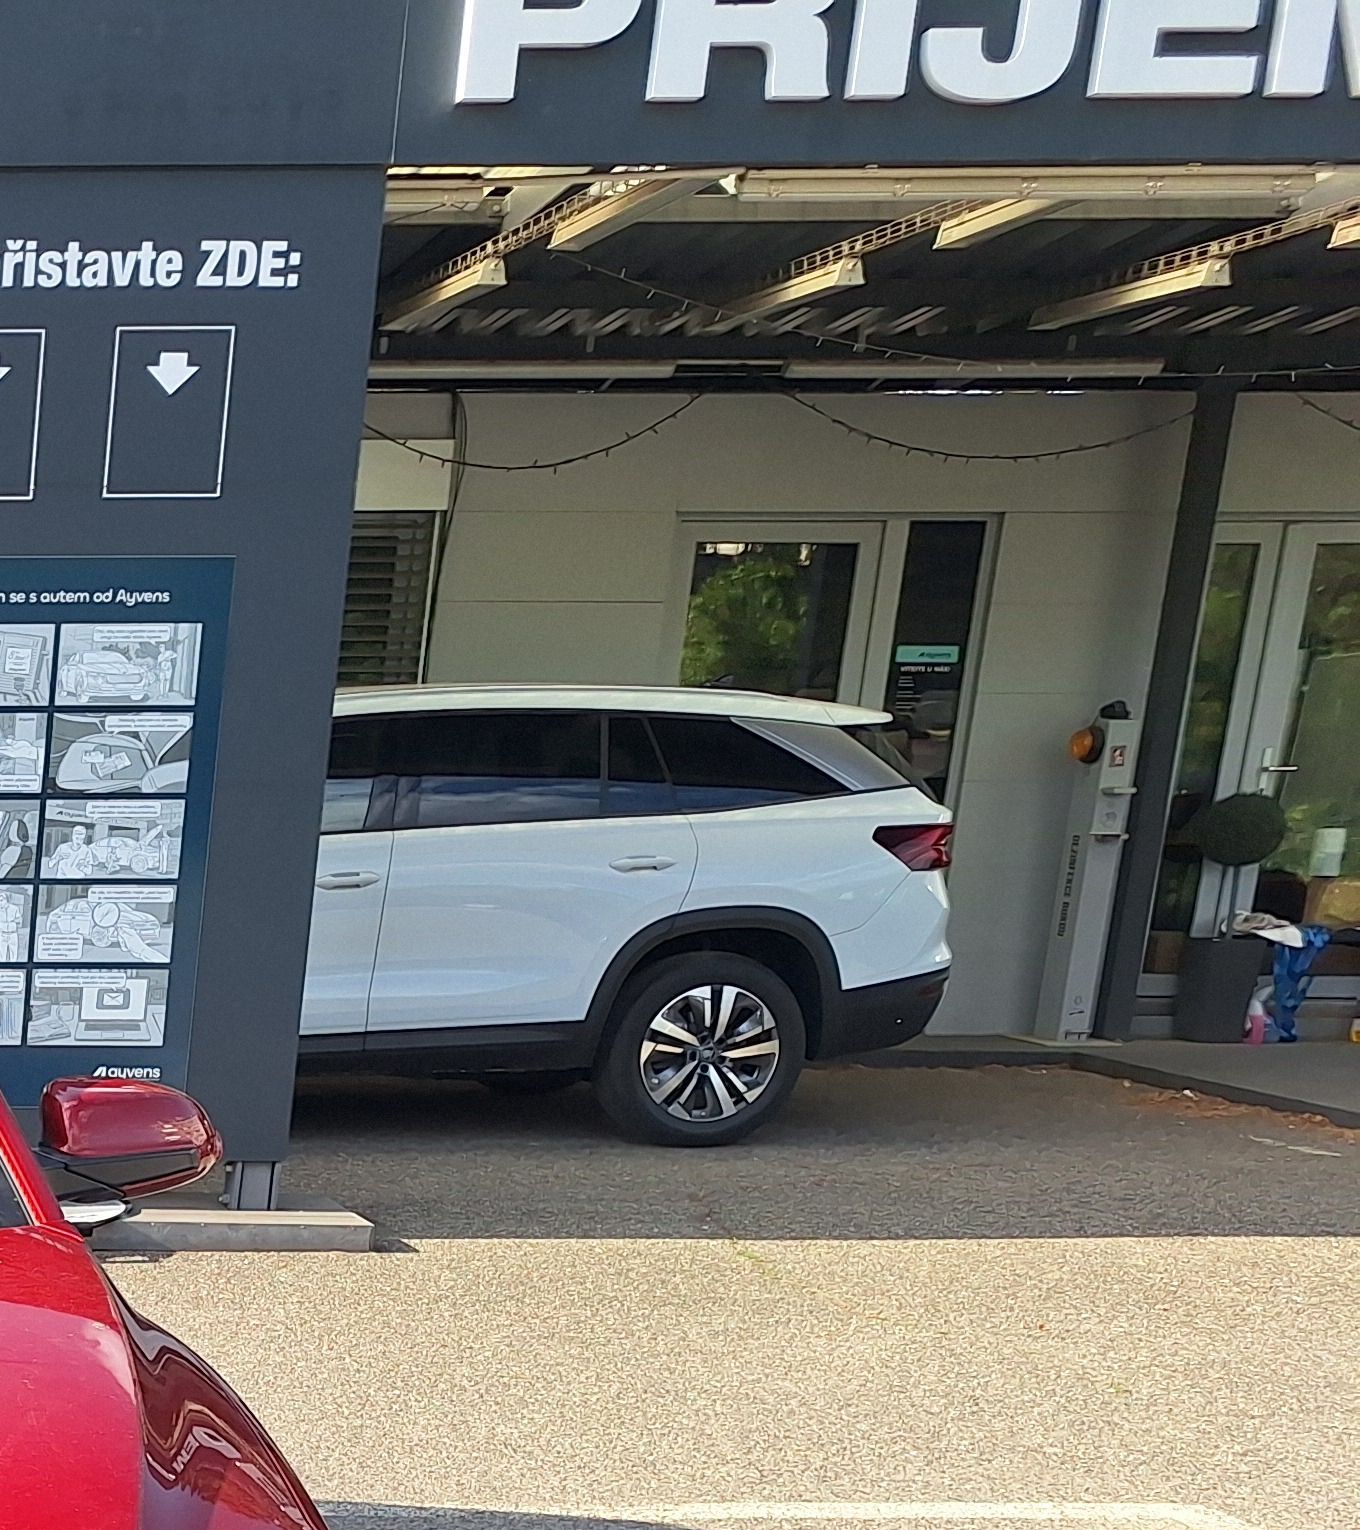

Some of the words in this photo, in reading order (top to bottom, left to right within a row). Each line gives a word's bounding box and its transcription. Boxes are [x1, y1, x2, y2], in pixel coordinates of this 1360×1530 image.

[195, 240, 302, 288] ZDE:
[9, 592, 26, 603] se
[29, 592, 38, 603] s
[40, 590, 90, 603] autem
[93, 588, 113, 603] od
[114, 588, 170, 606] Ayvens
[107, 1066, 161, 1079] ayvens
